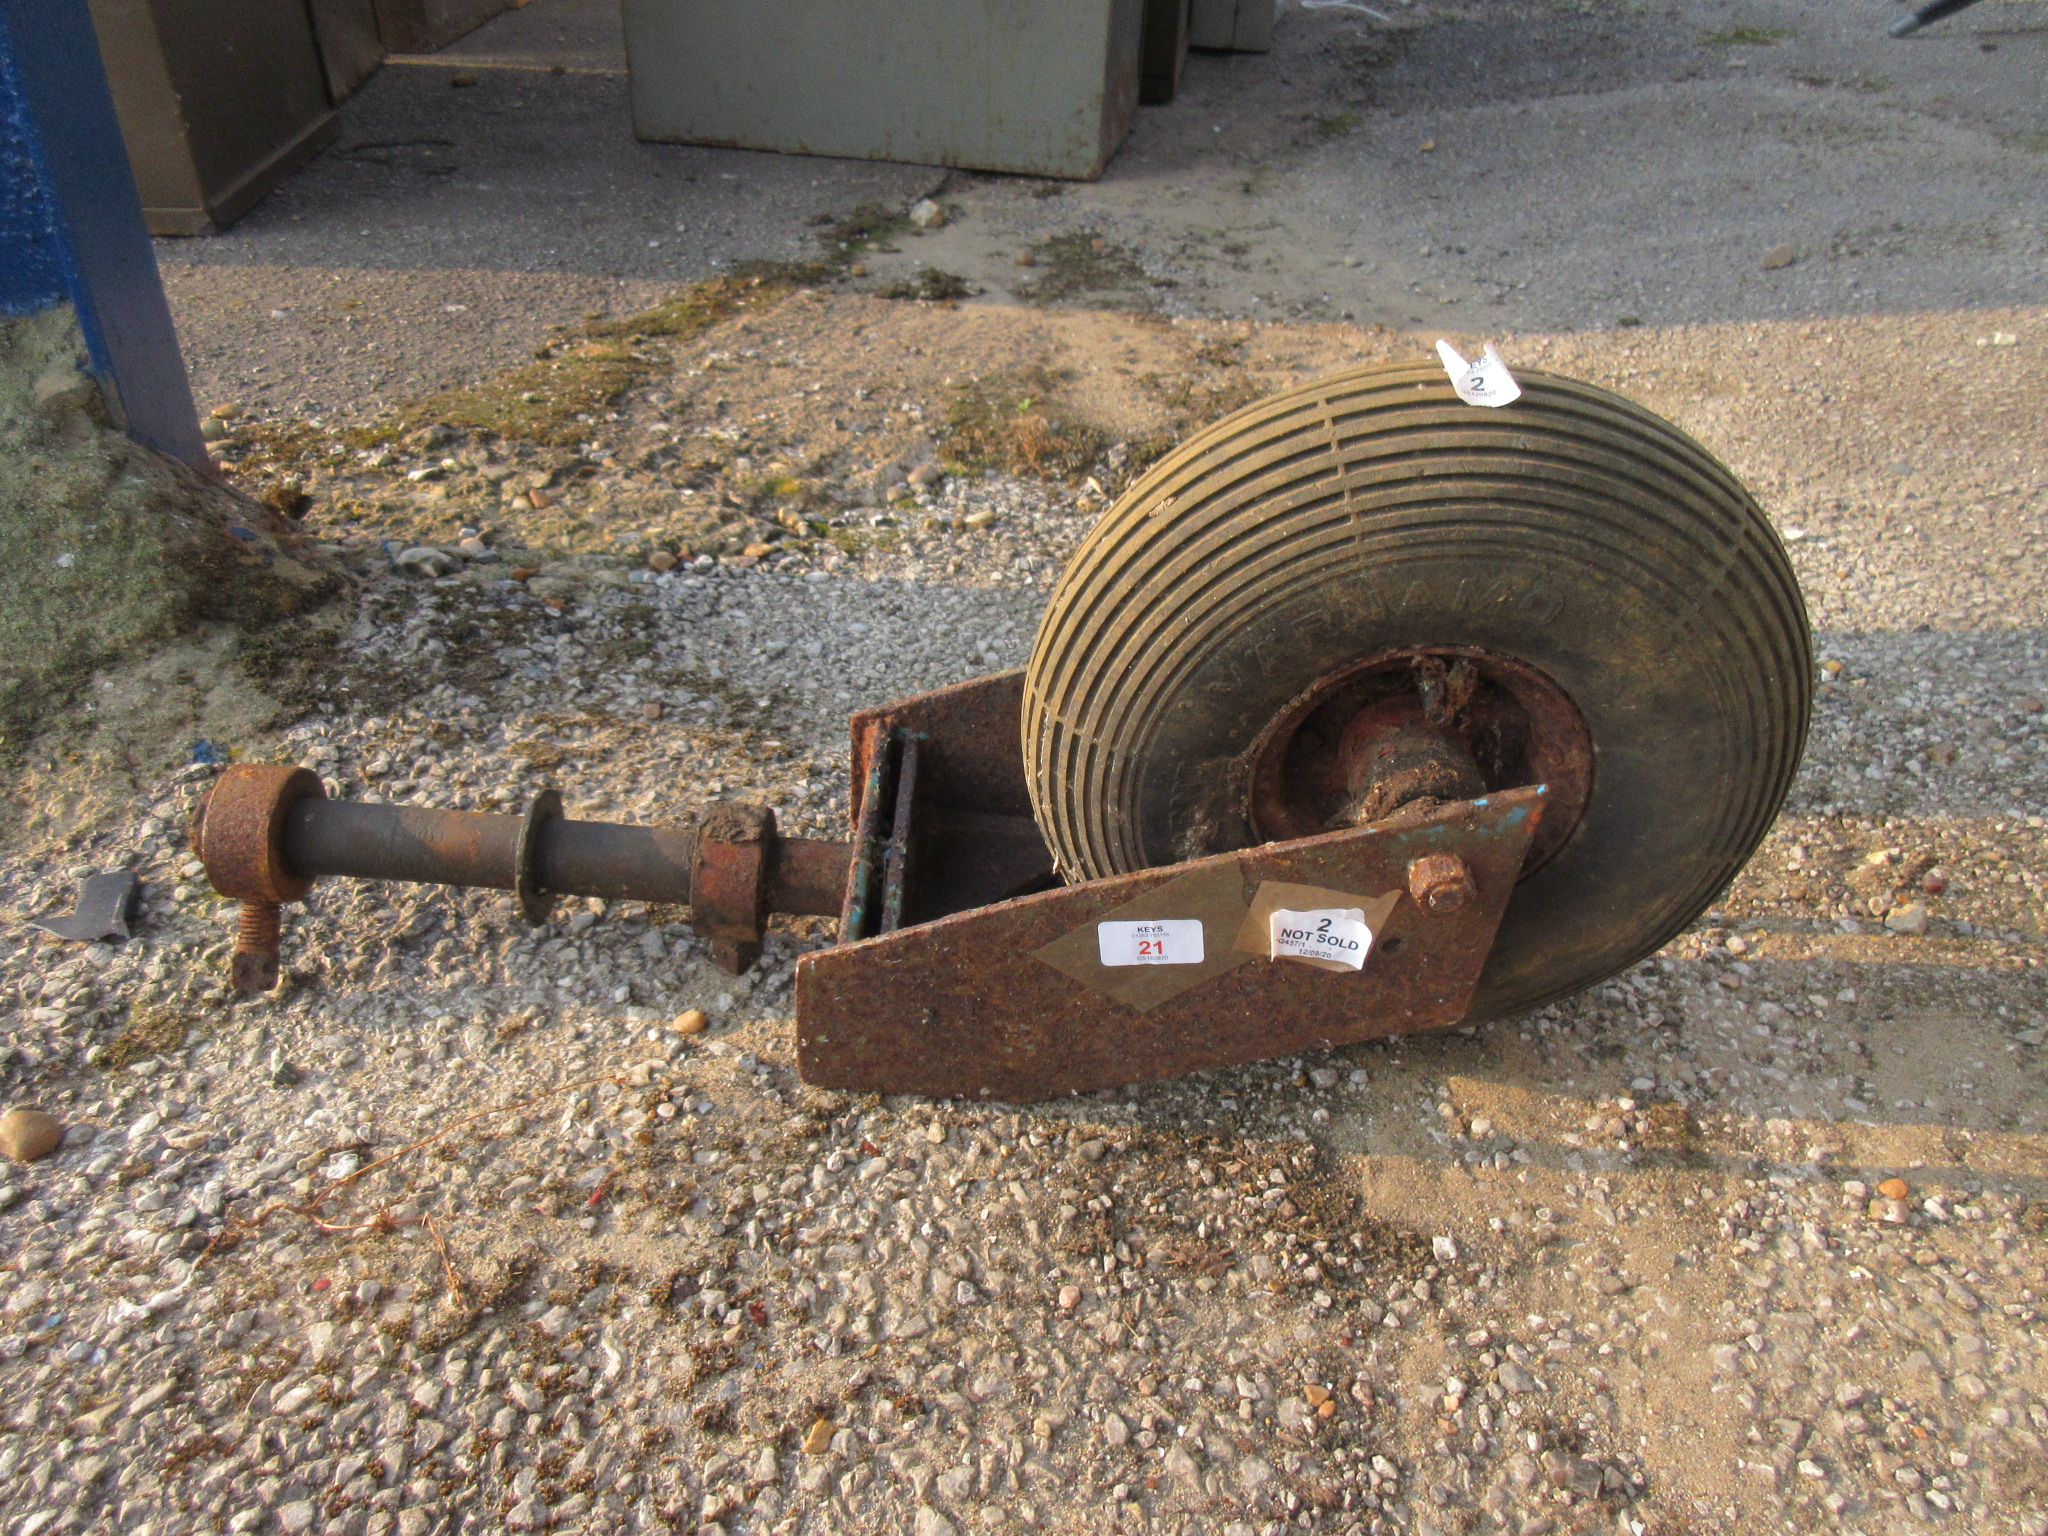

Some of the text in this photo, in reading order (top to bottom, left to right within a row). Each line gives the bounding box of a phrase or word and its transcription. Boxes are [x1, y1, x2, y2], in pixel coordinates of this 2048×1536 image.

[1470, 378, 1485, 391] 2
[1316, 918, 1332, 932] 2
[1281, 929, 1359, 950] NOT SOLD
[1138, 940, 1162, 954] 21
[1299, 948, 1331, 958] 12/08/20
